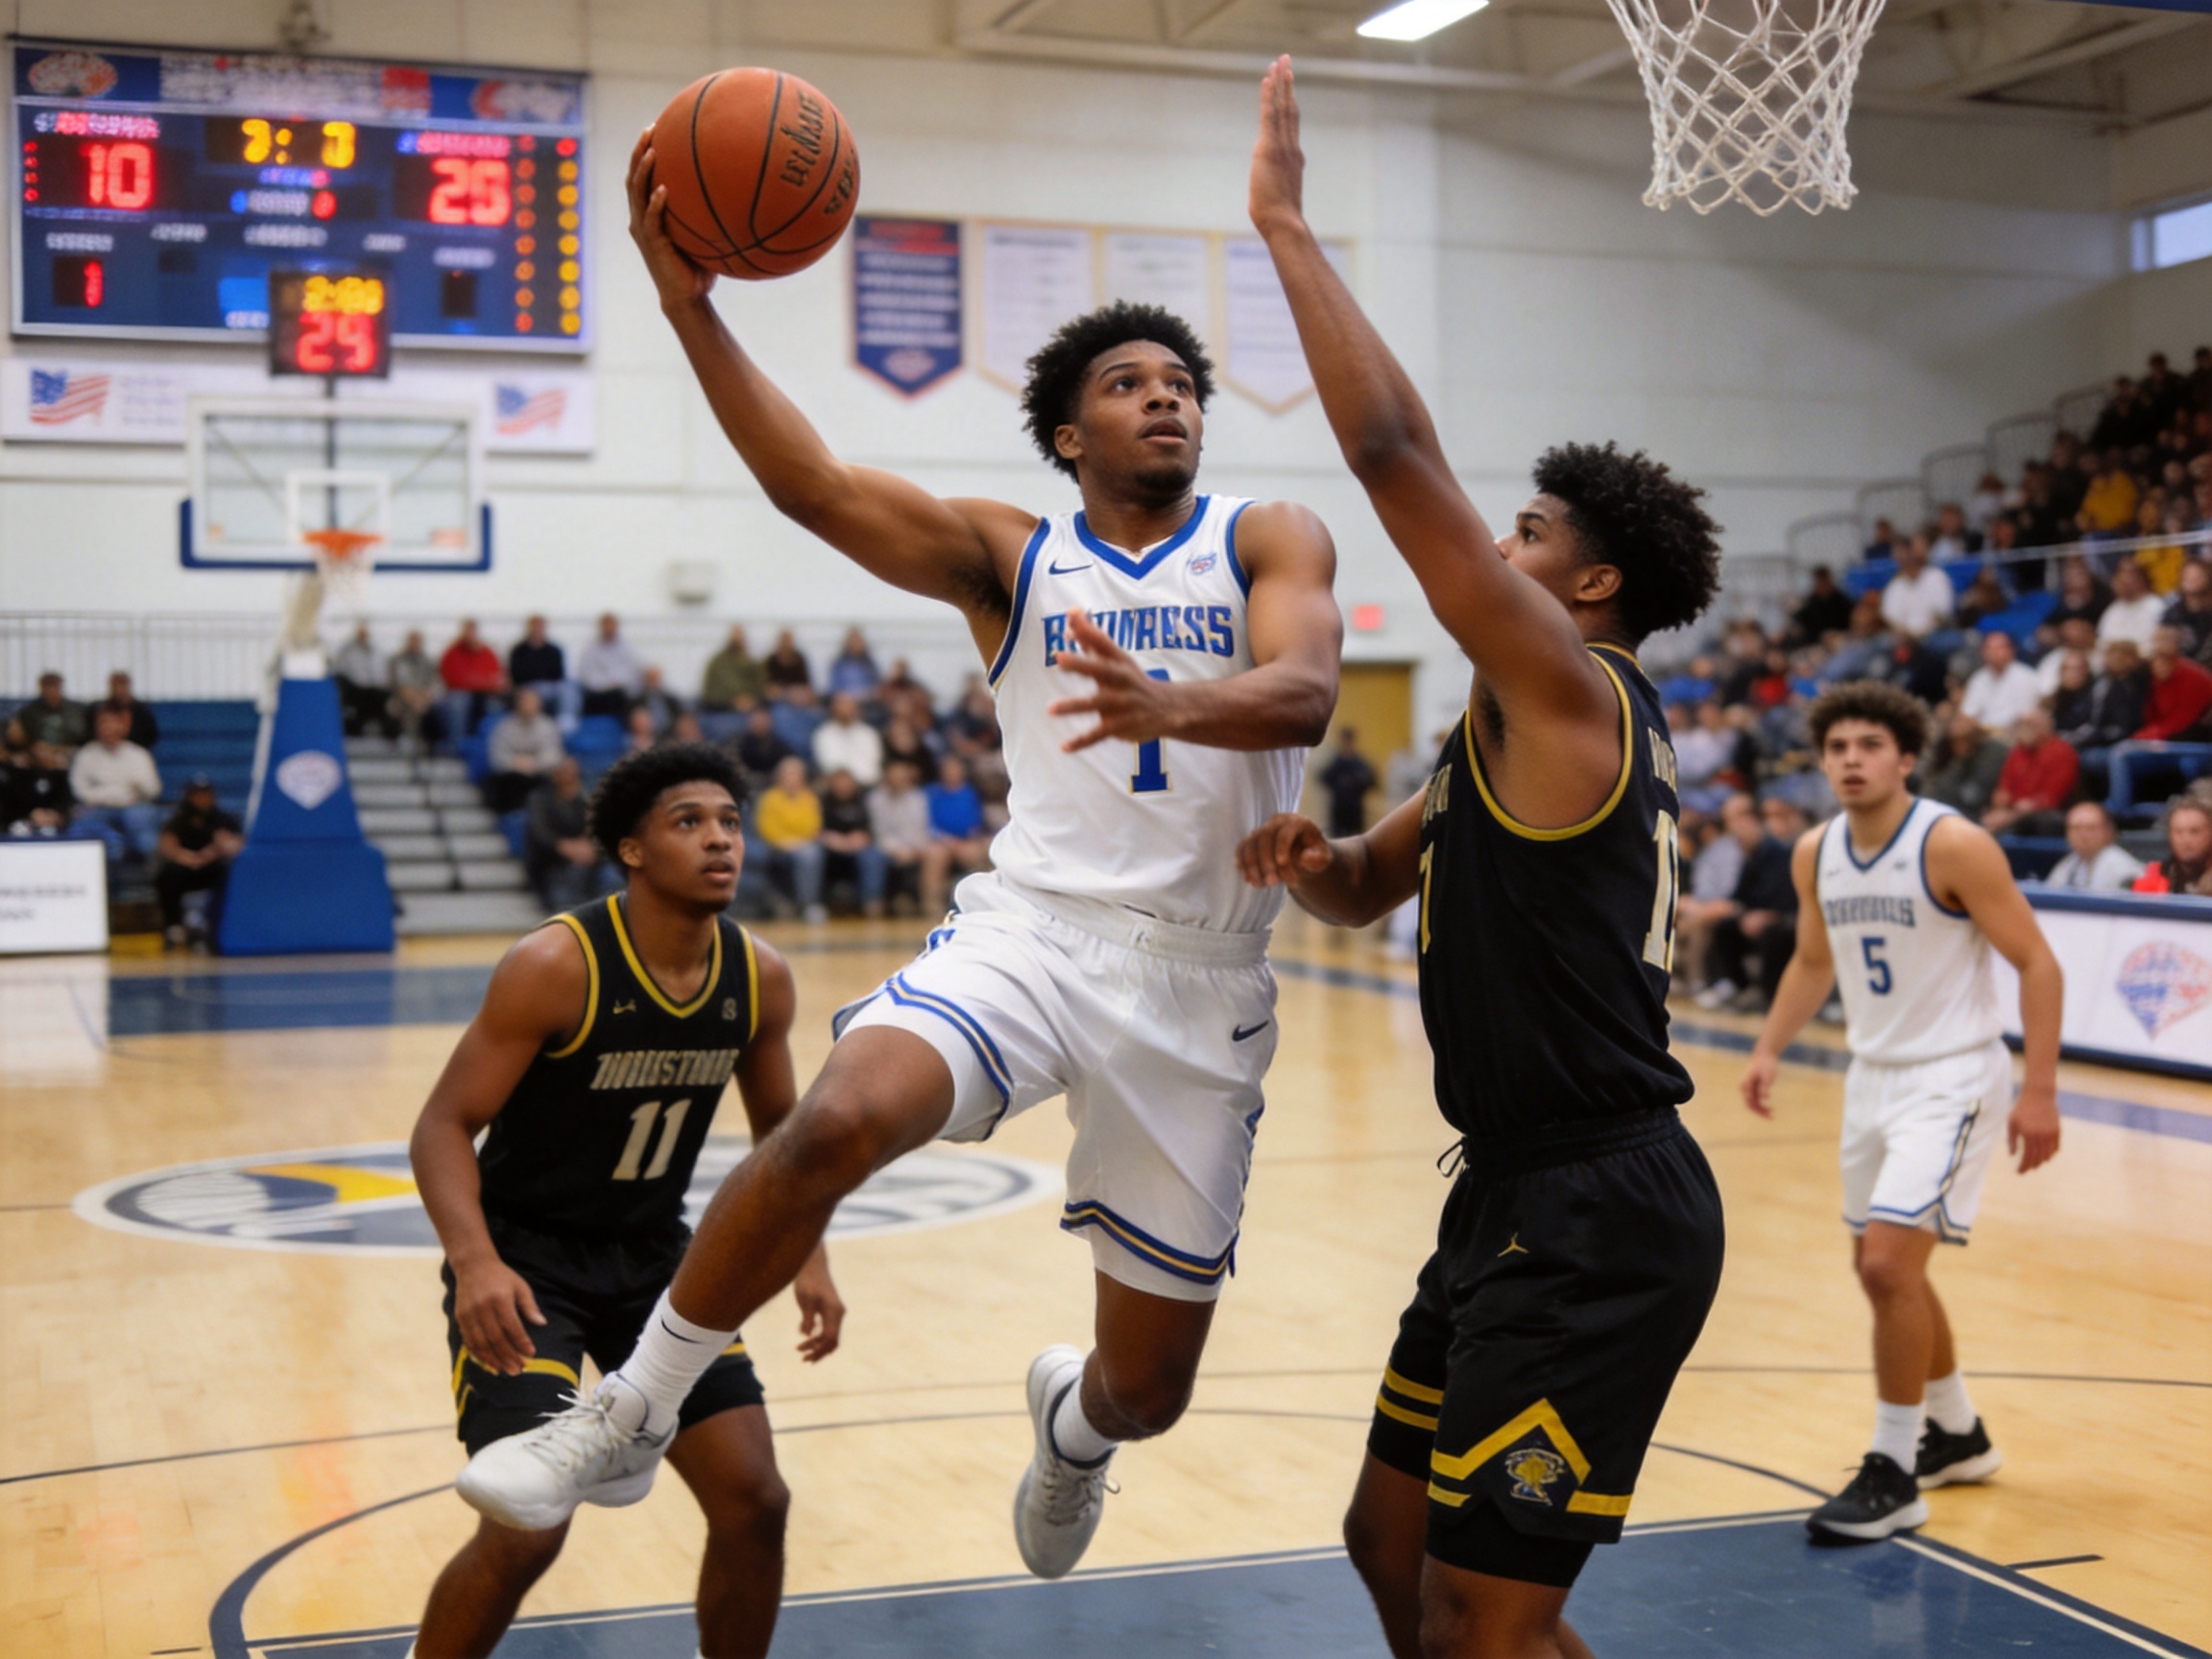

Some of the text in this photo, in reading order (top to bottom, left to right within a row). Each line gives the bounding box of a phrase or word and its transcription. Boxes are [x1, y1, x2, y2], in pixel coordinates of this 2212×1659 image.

[80, 141, 154, 208] 10
[84, 261, 103, 307] 1
[1861, 936, 1894, 996] 5
[612, 1099, 692, 1181] 11
